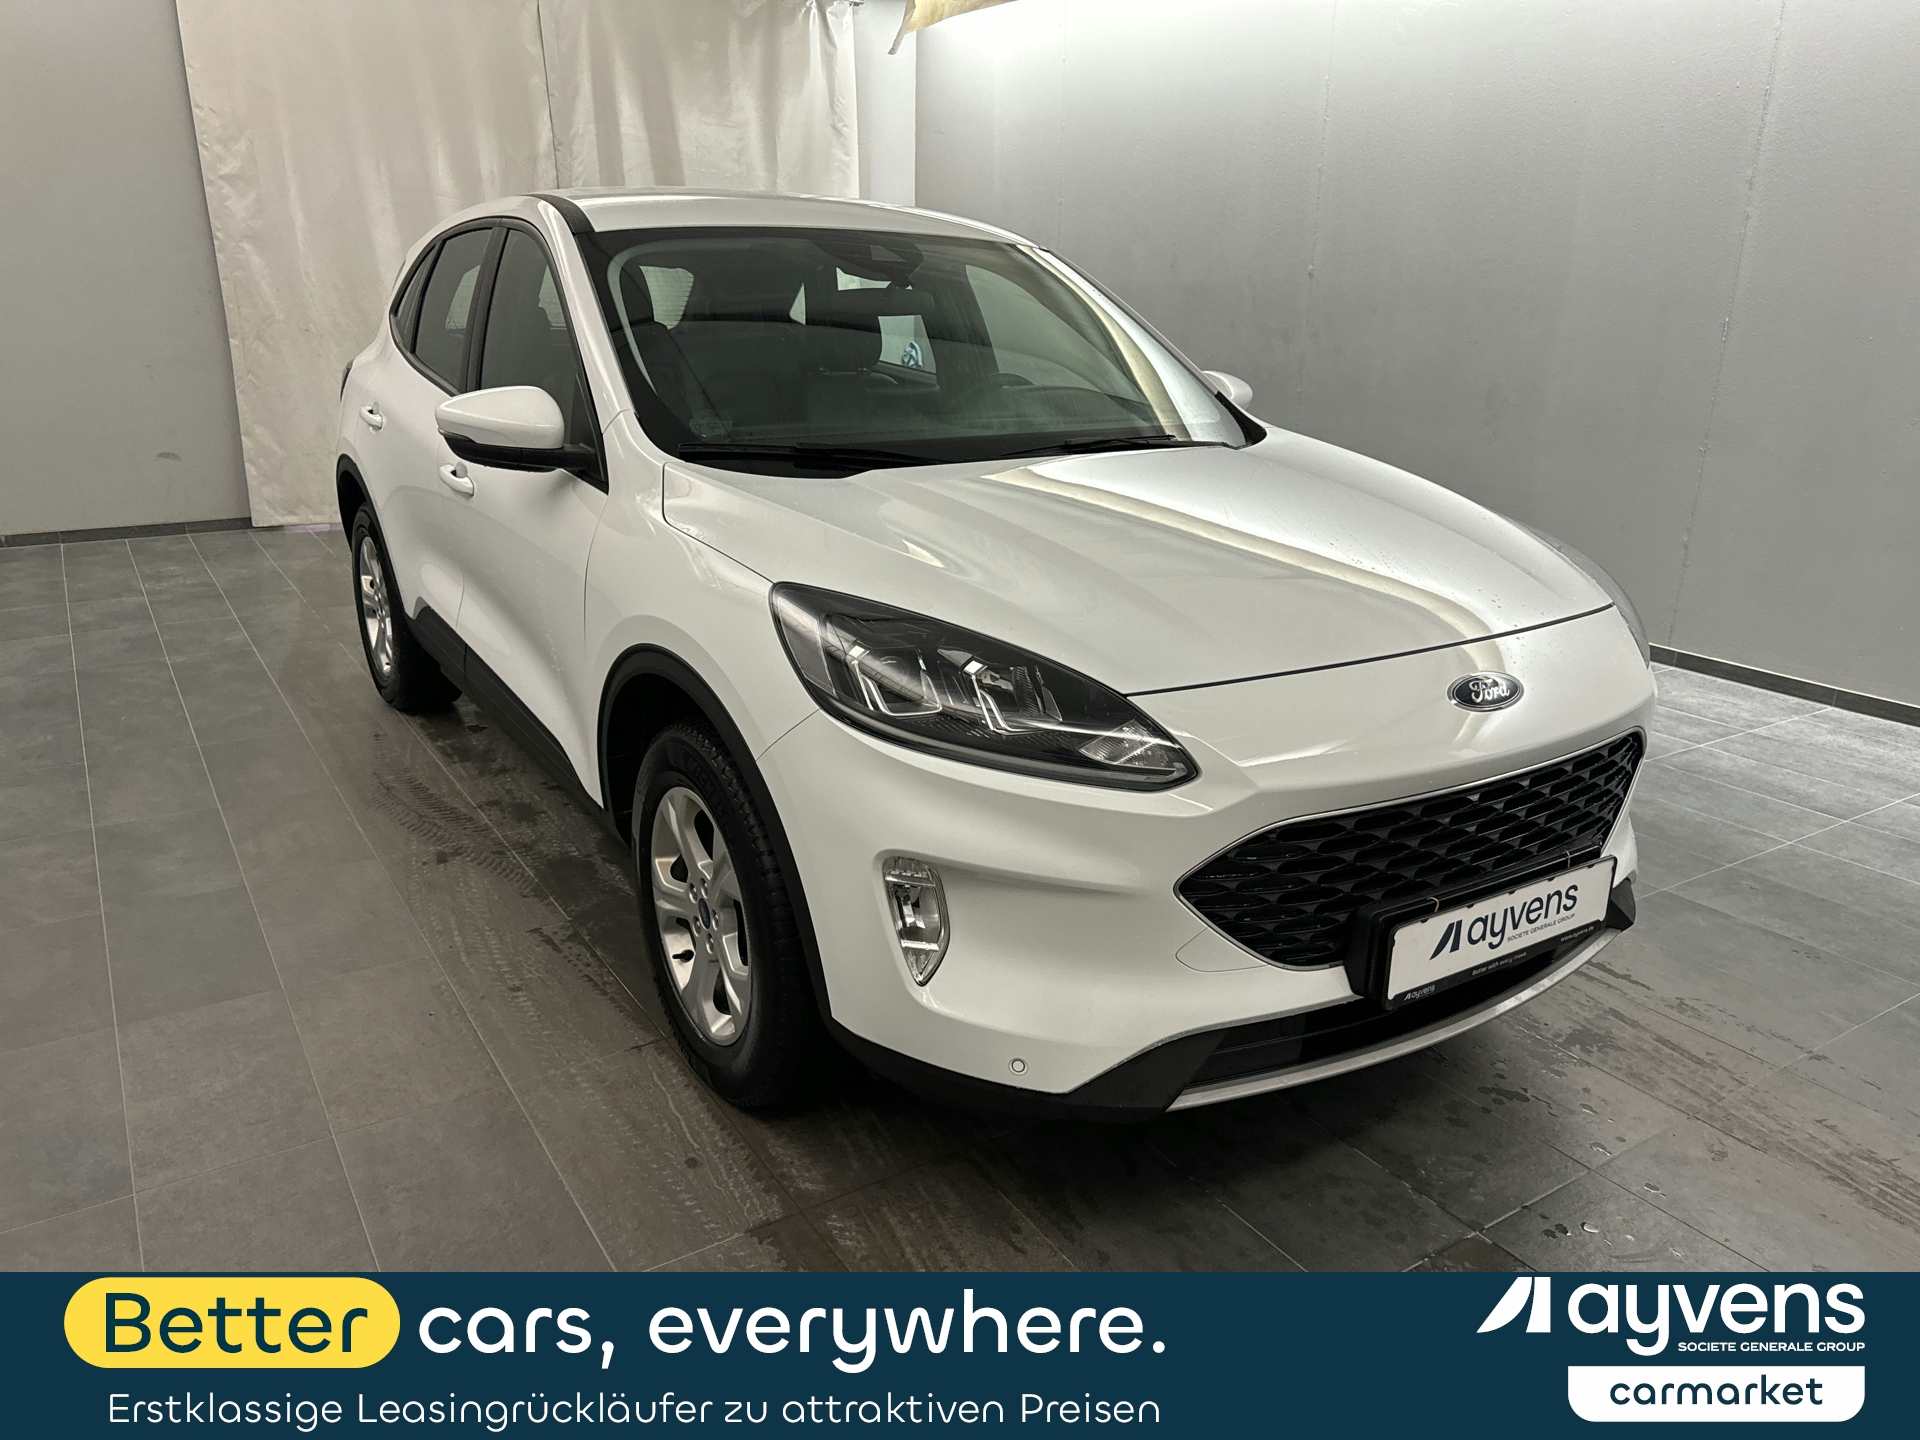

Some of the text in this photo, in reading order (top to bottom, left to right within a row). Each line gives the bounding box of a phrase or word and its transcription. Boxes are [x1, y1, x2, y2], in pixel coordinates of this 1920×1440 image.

[1469, 680, 1510, 703] Ford
[1467, 884, 1578, 950] ayvens
[1507, 913, 1576, 942] SOCIETE GENERALE GROUP
[1411, 984, 1436, 999] ayvens
